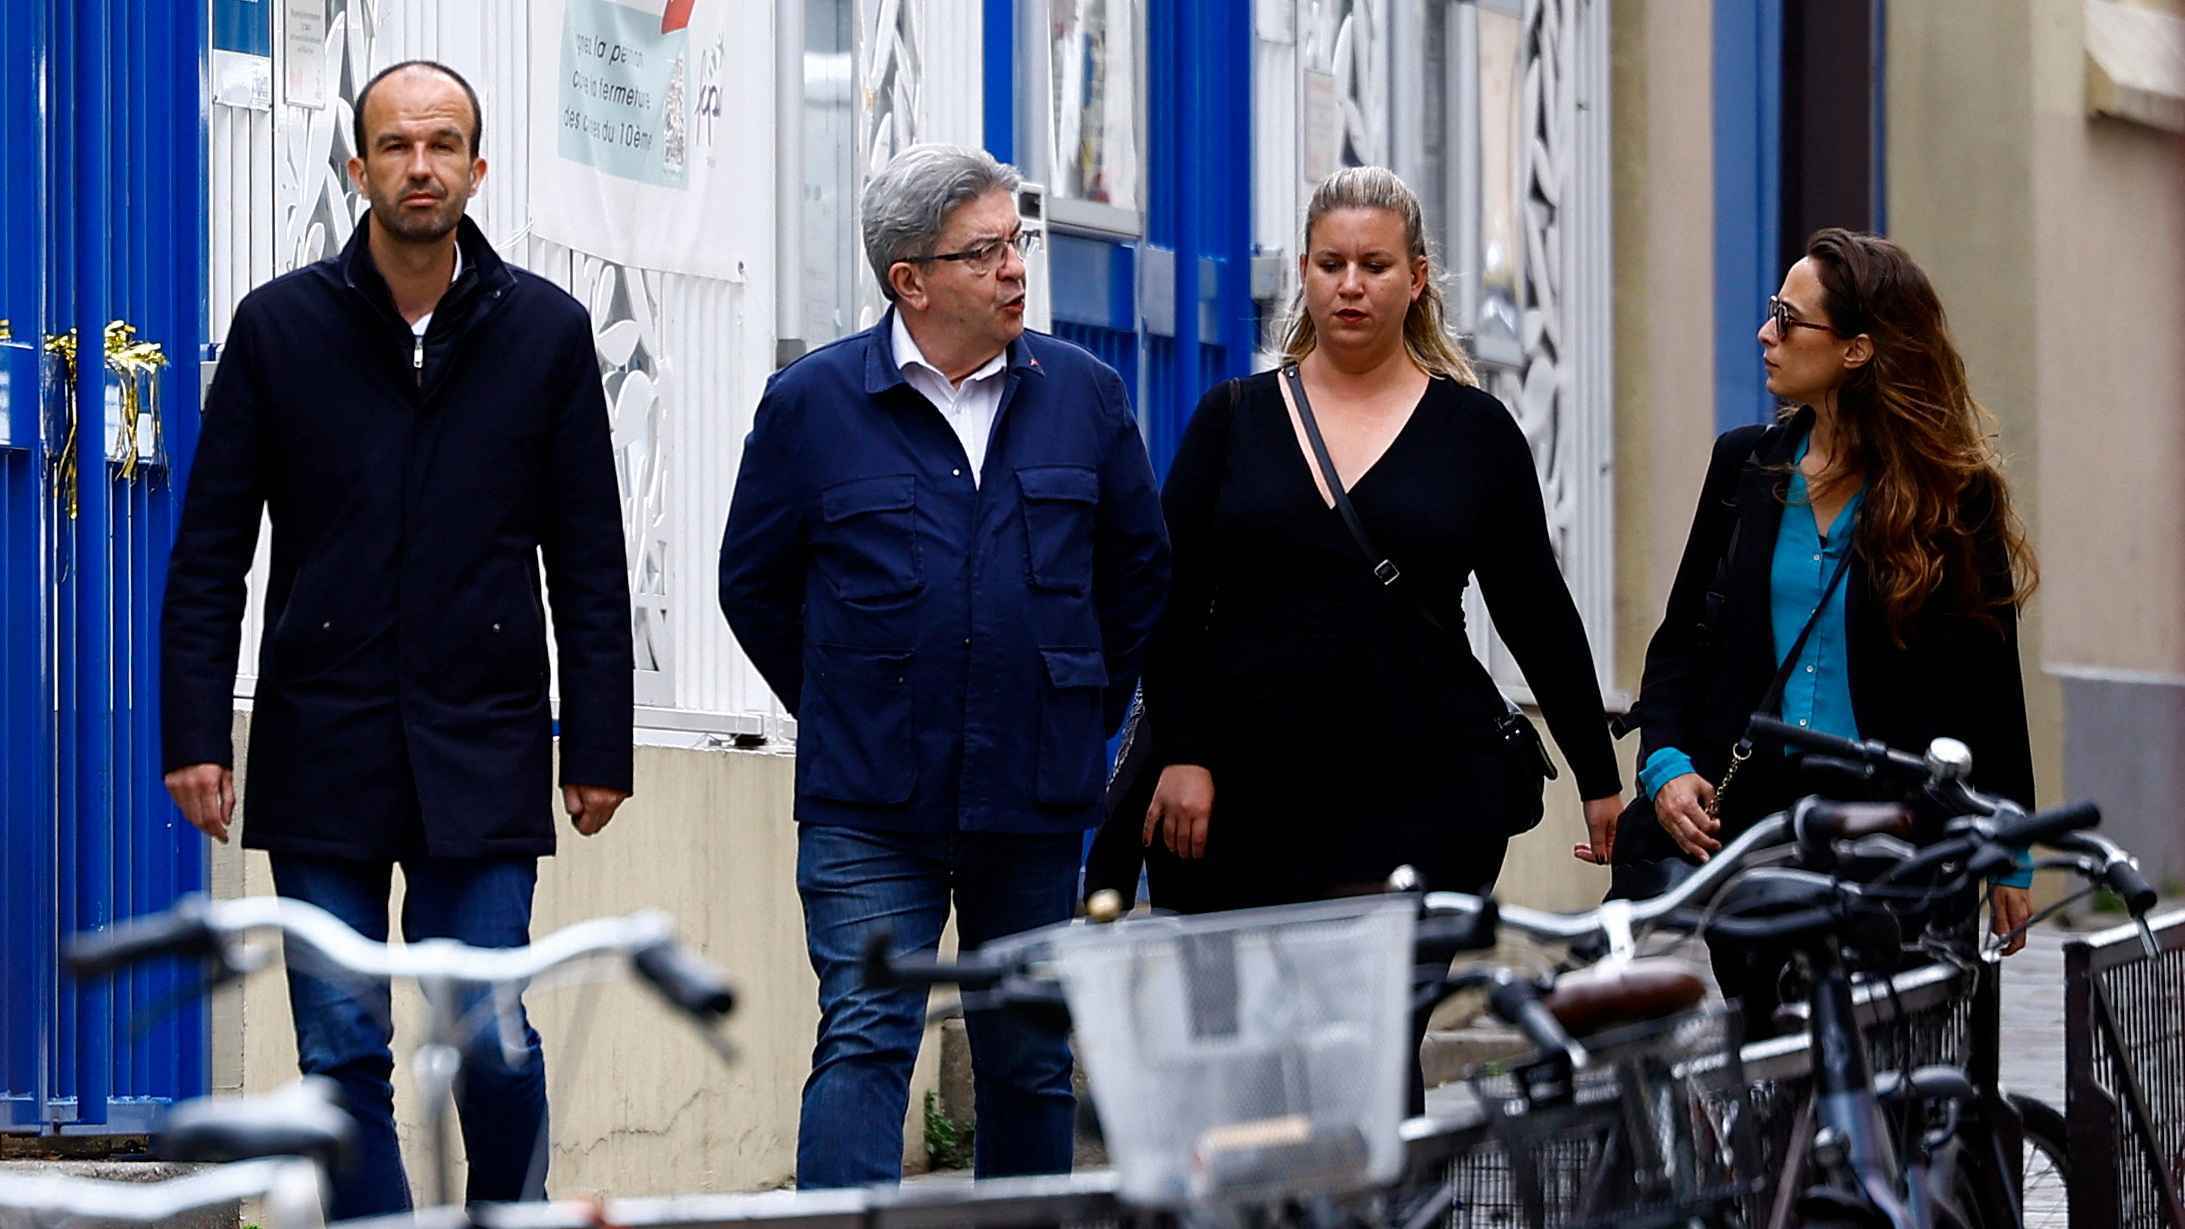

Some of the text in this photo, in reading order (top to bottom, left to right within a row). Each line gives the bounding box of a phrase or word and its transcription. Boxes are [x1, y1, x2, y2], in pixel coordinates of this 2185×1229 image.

[593, 34, 607, 59] la
[564, 105, 580, 130] des
[602, 120, 615, 143] du
